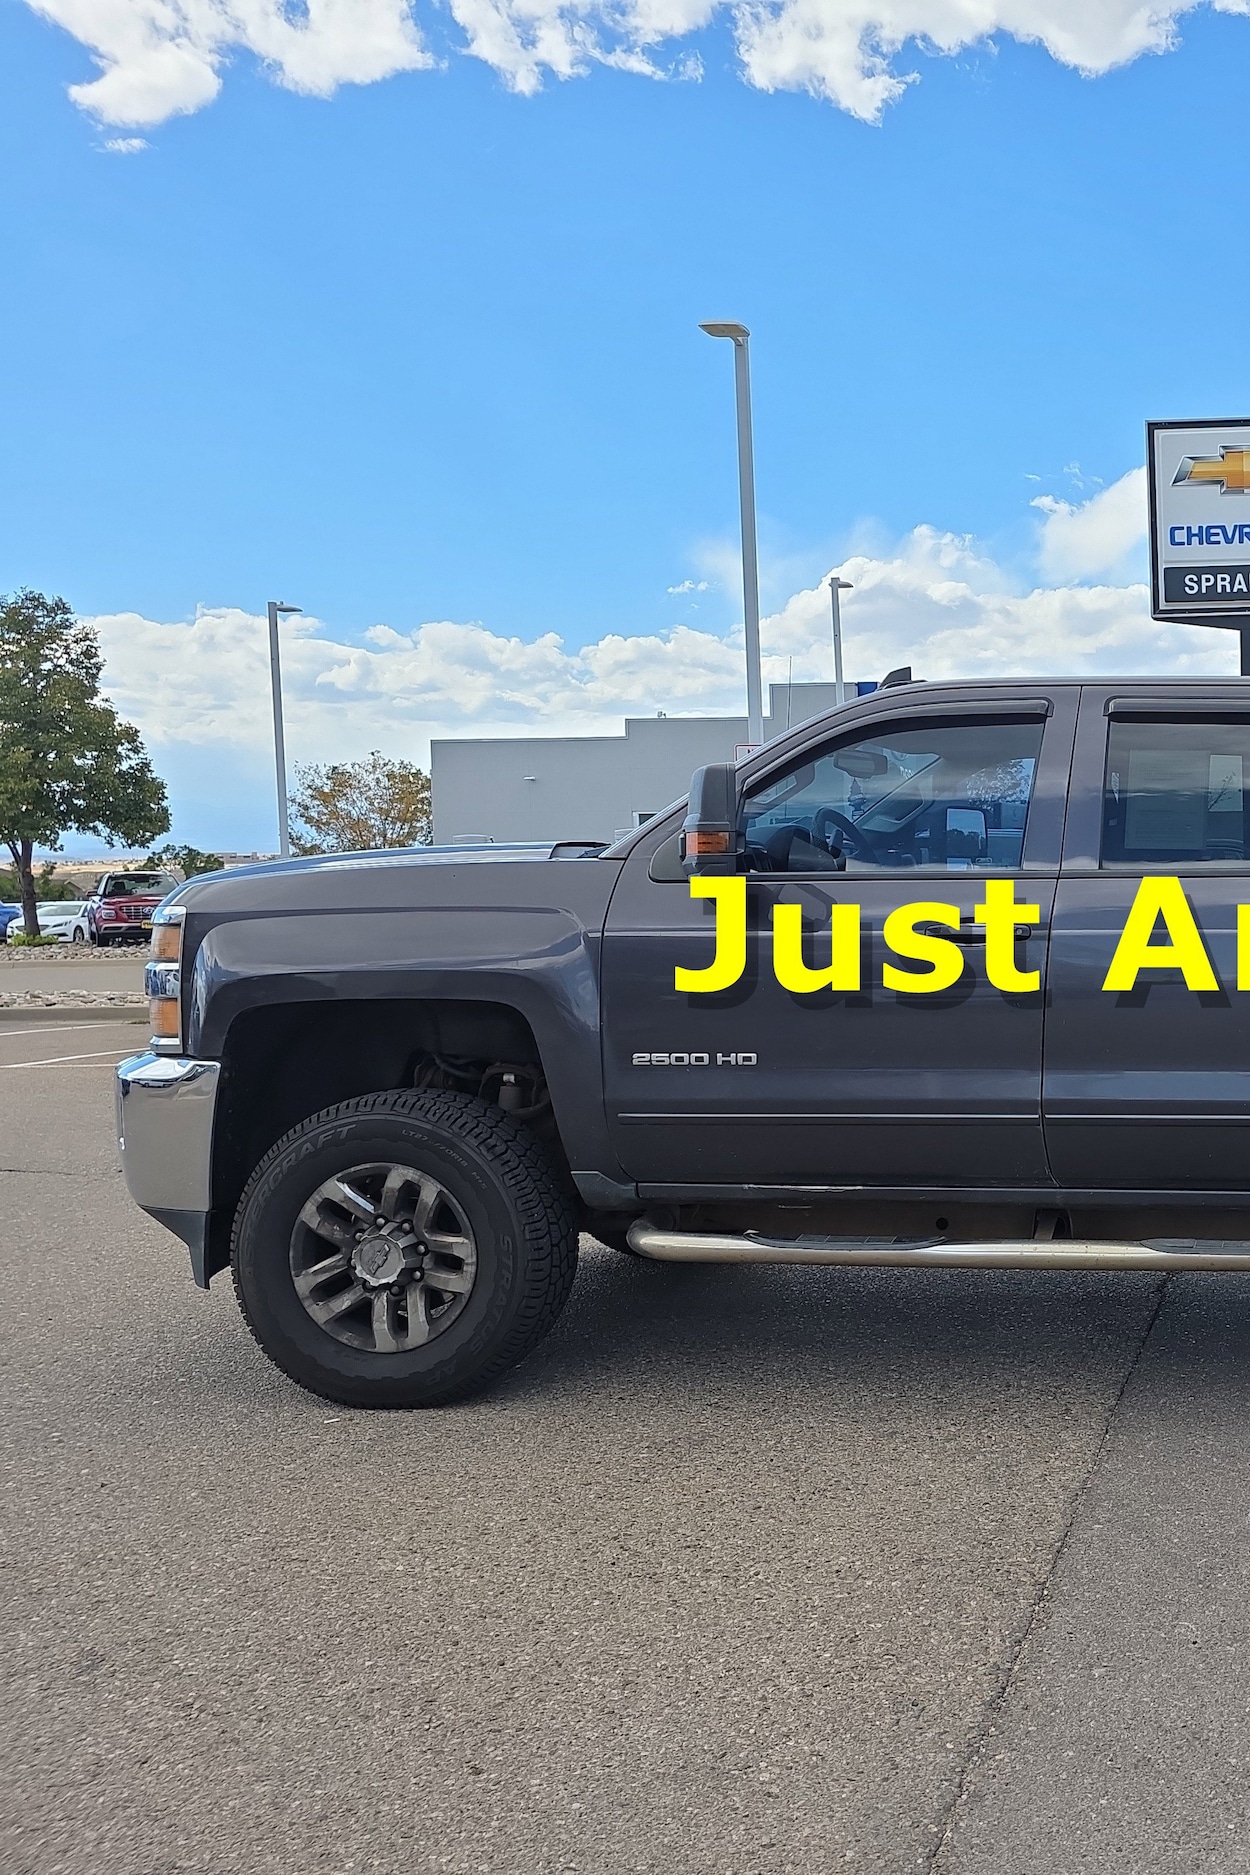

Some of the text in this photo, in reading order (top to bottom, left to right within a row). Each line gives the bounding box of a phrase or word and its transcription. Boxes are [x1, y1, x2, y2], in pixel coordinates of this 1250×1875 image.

[632, 1053, 757, 1066] 2500 HD
[471, 1235, 514, 1355] STRATUS
